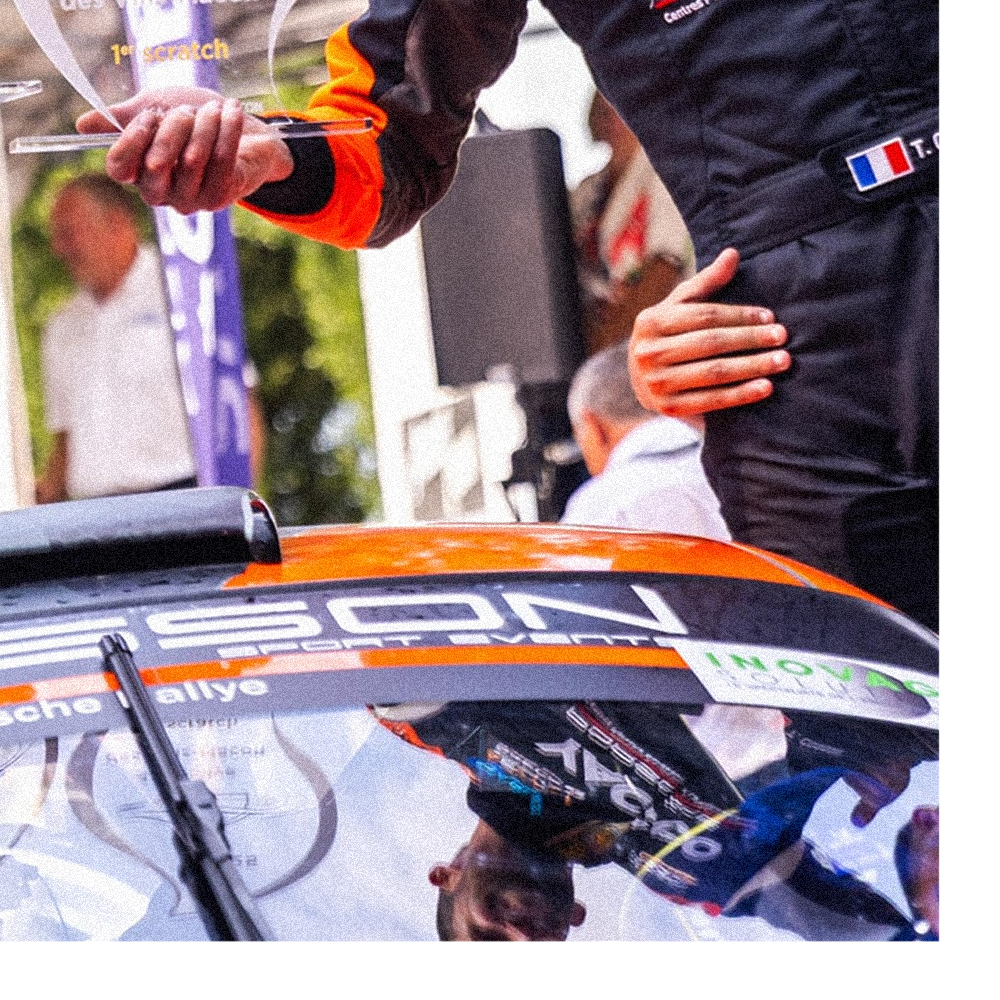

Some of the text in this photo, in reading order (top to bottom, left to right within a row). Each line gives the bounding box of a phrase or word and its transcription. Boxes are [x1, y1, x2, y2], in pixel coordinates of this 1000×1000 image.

[142, 37, 230, 64] scratch
[216, 635, 421, 658] SPORT
[118, 676, 269, 711] allye
